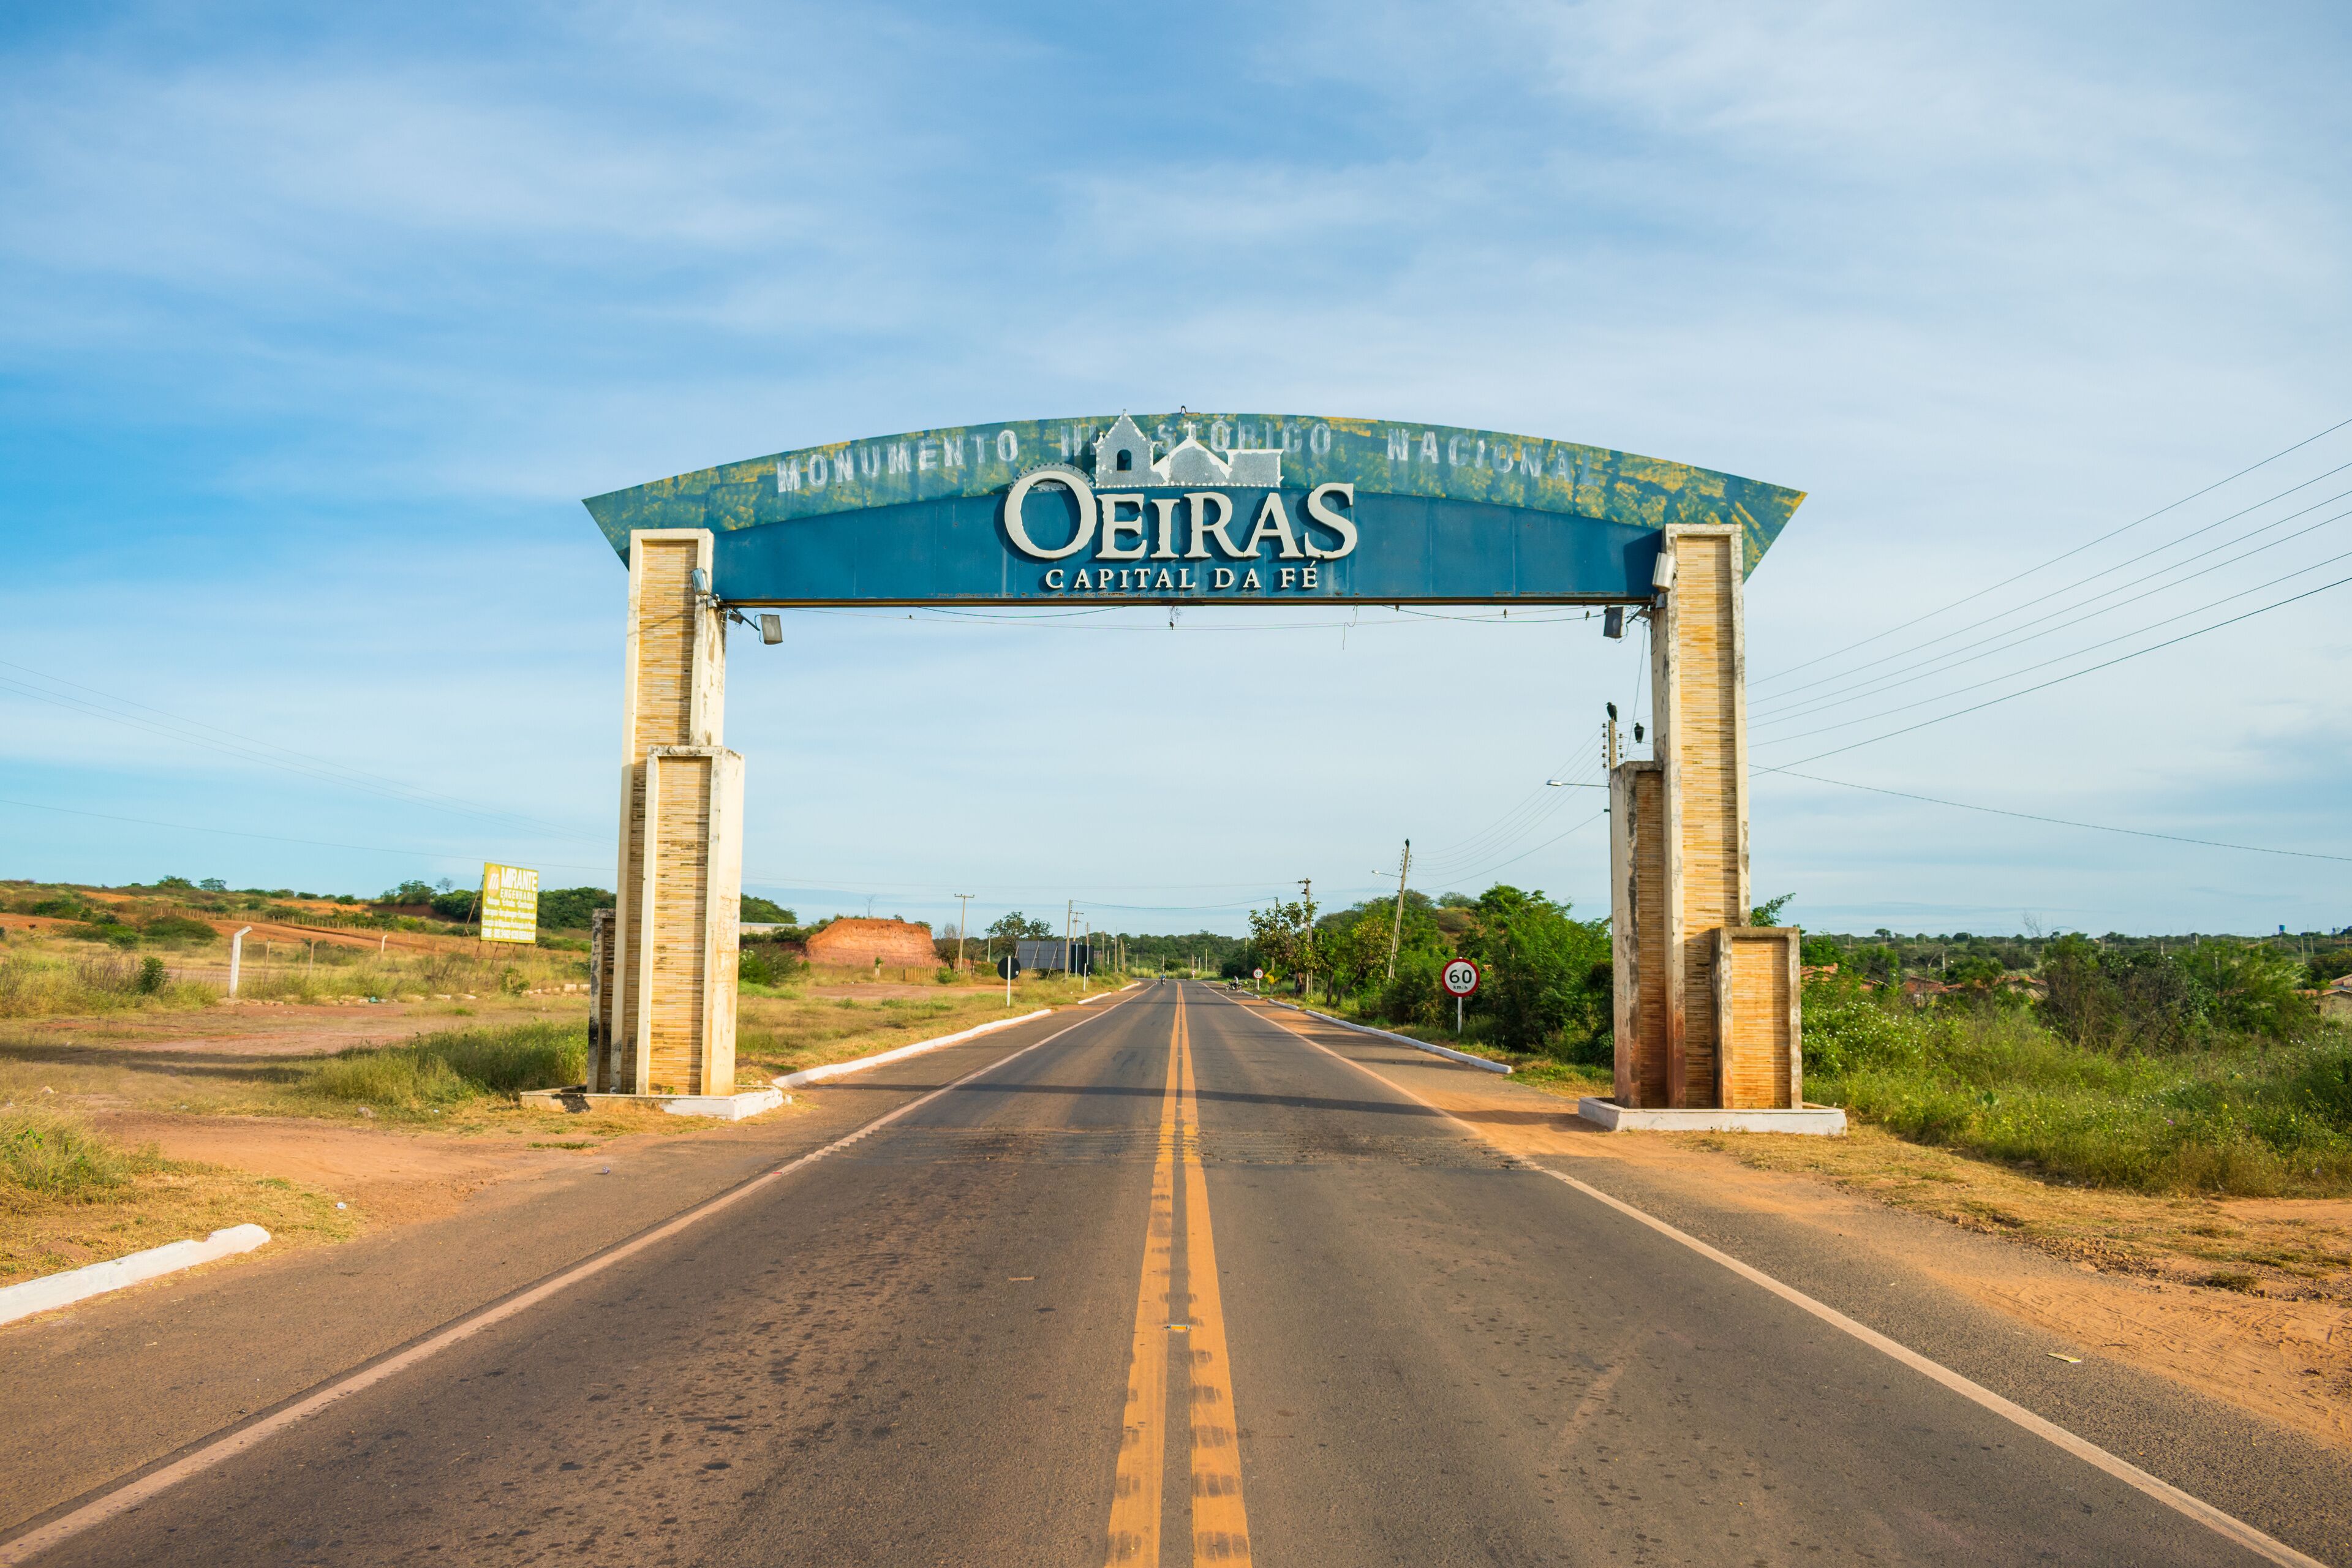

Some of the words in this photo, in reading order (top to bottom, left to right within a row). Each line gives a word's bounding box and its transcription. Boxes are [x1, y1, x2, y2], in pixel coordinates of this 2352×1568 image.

[777, 429, 1019, 492] MONUMENTO
[1387, 428, 1600, 486] NACIONAL
[1046, 568, 1196, 589] CAPITAL
[1215, 568, 1262, 588] DA
[1280, 560, 1318, 588] FÉ
[1449, 970, 1472, 984] 60
